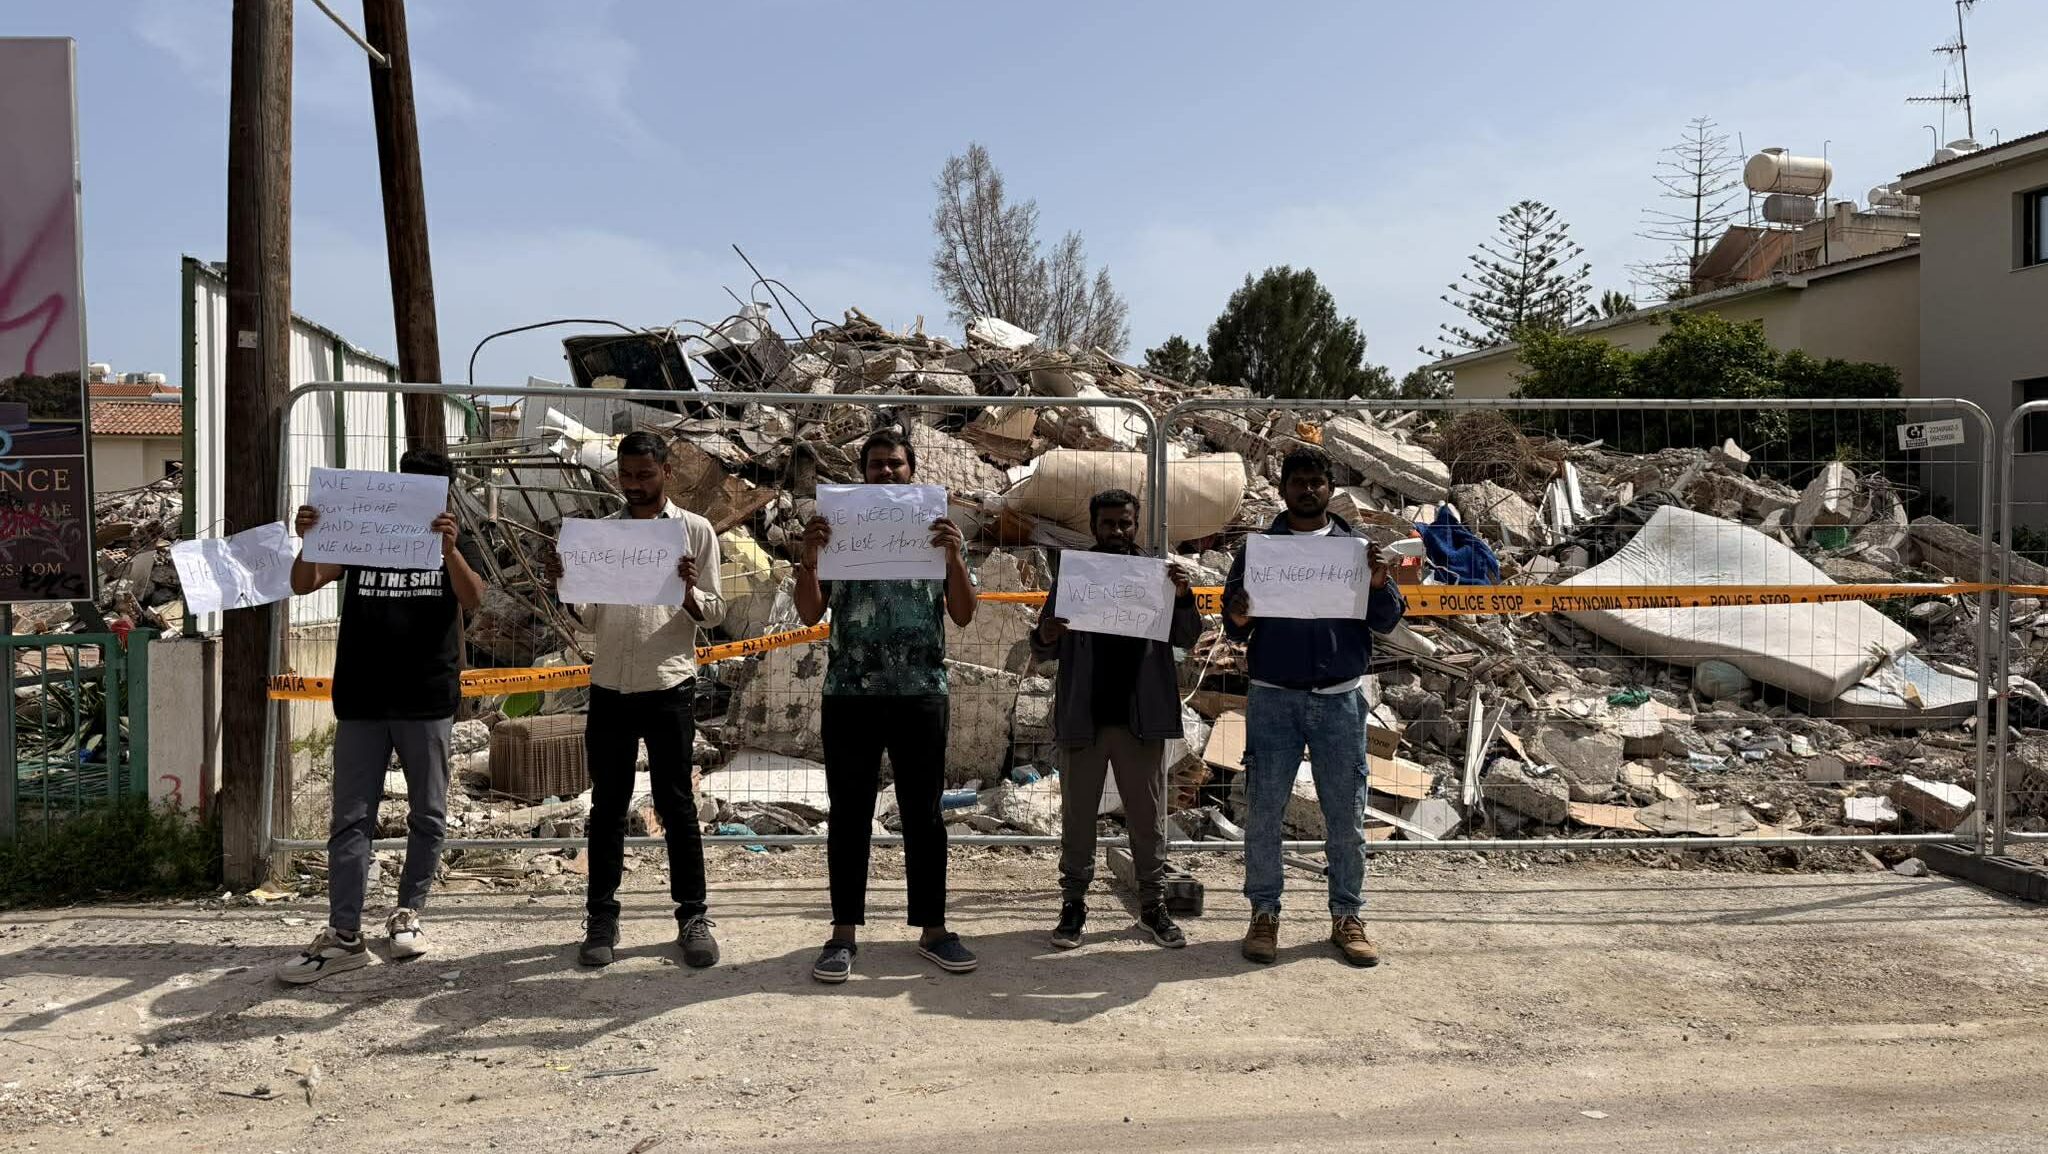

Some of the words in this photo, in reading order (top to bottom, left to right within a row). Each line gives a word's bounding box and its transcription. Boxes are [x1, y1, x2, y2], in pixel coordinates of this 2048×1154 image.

[318, 476, 352, 491] WE
[857, 506, 904, 526] NEED
[318, 520, 354, 535] AND
[317, 541, 339, 553] WE
[822, 539, 849, 555] WE
[563, 549, 618, 570] PLEASE
[621, 547, 668, 569] HELP
[359, 570, 376, 587] IN
[380, 572, 407, 588] THE
[410, 570, 443, 587] SHIT
[1250, 566, 1273, 583] WE
[1279, 565, 1315, 582] NEED
[359, 588, 375, 596] JUST
[376, 589, 388, 597] THE
[1068, 582, 1099, 602] WE
[1103, 583, 1146, 600] NEED
[1440, 595, 1486, 611] POLICE
[1490, 595, 1523, 611] STOP
